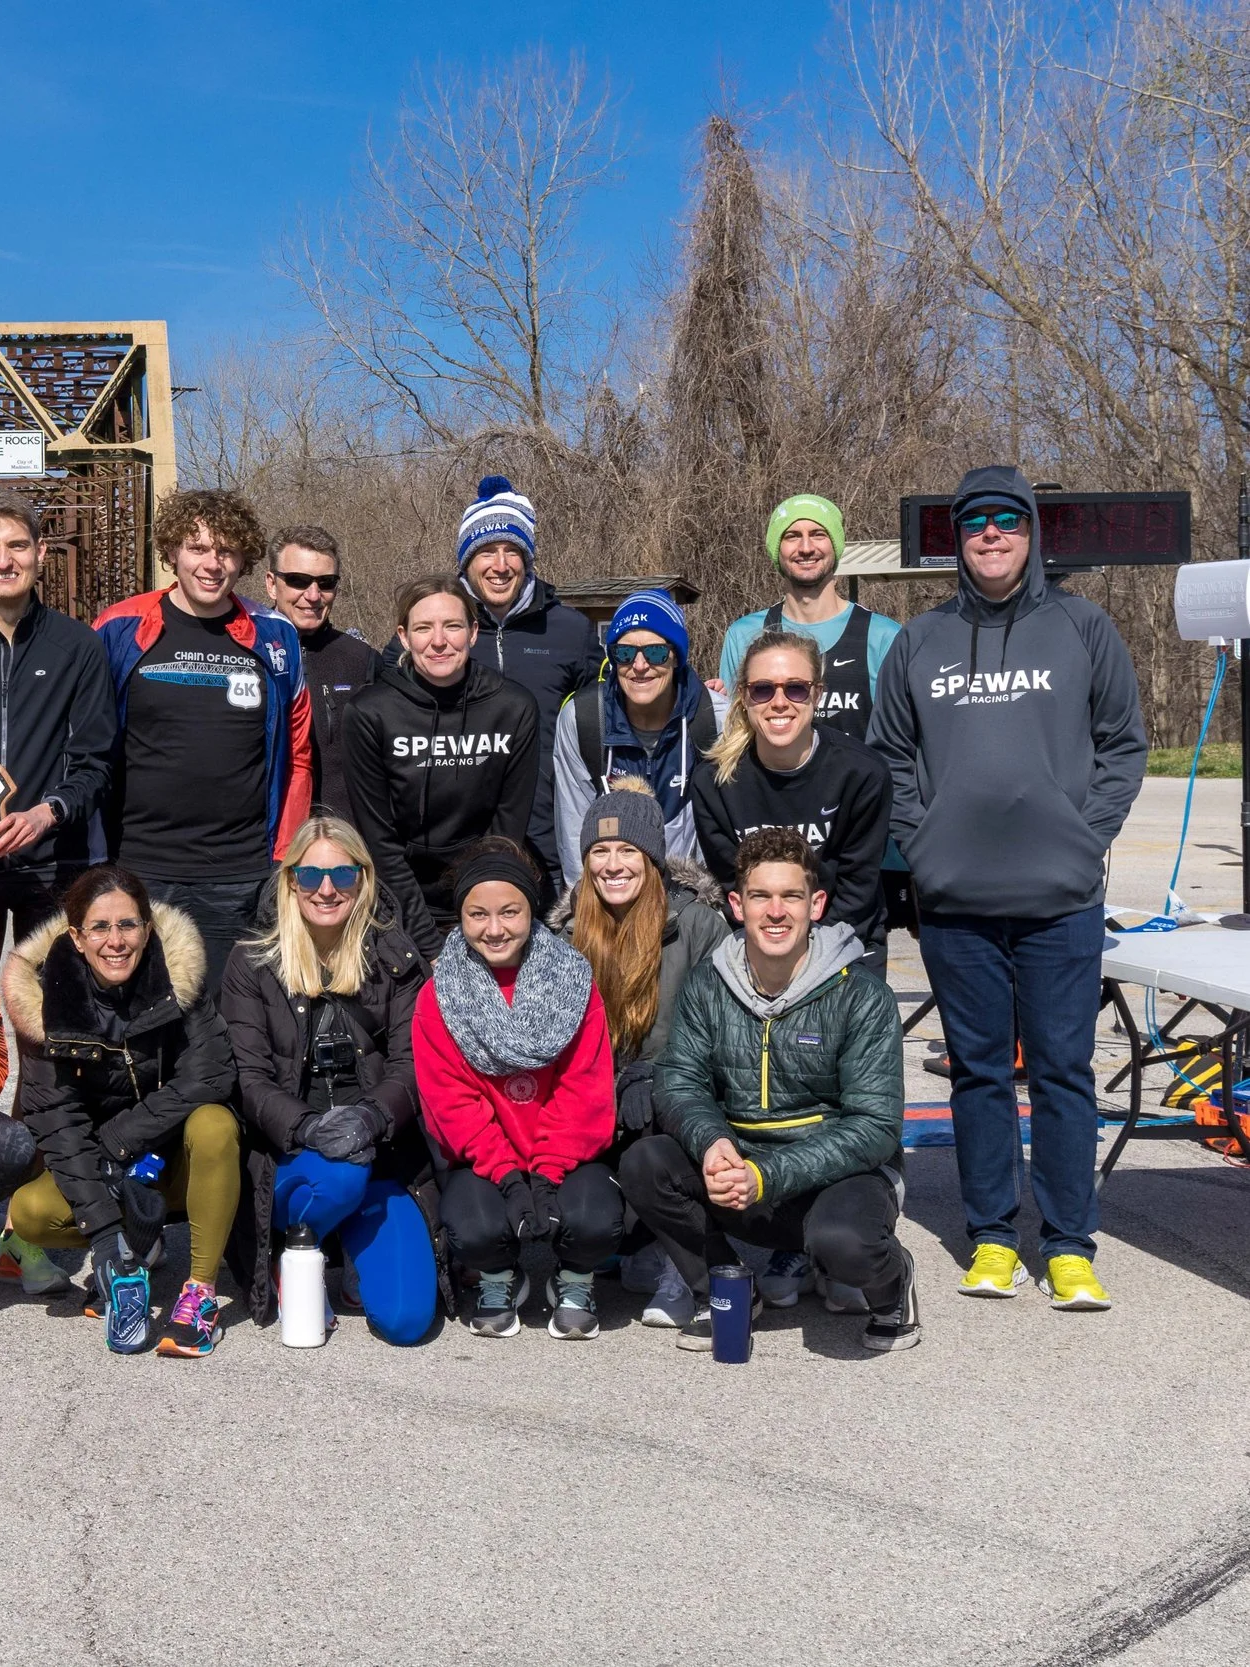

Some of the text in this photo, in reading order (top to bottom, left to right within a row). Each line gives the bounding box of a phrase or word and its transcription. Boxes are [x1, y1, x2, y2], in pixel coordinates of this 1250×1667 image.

[5, 436, 41, 445] ROCKS
[470, 522, 509, 540] SPEWAK
[174, 651, 256, 667] CHAIN OF ROCKS
[233, 682, 256, 698] 6K
[930, 669, 1052, 698] SPEWAK
[971, 694, 1010, 704] RACING
[392, 733, 511, 757] SPEWAK
